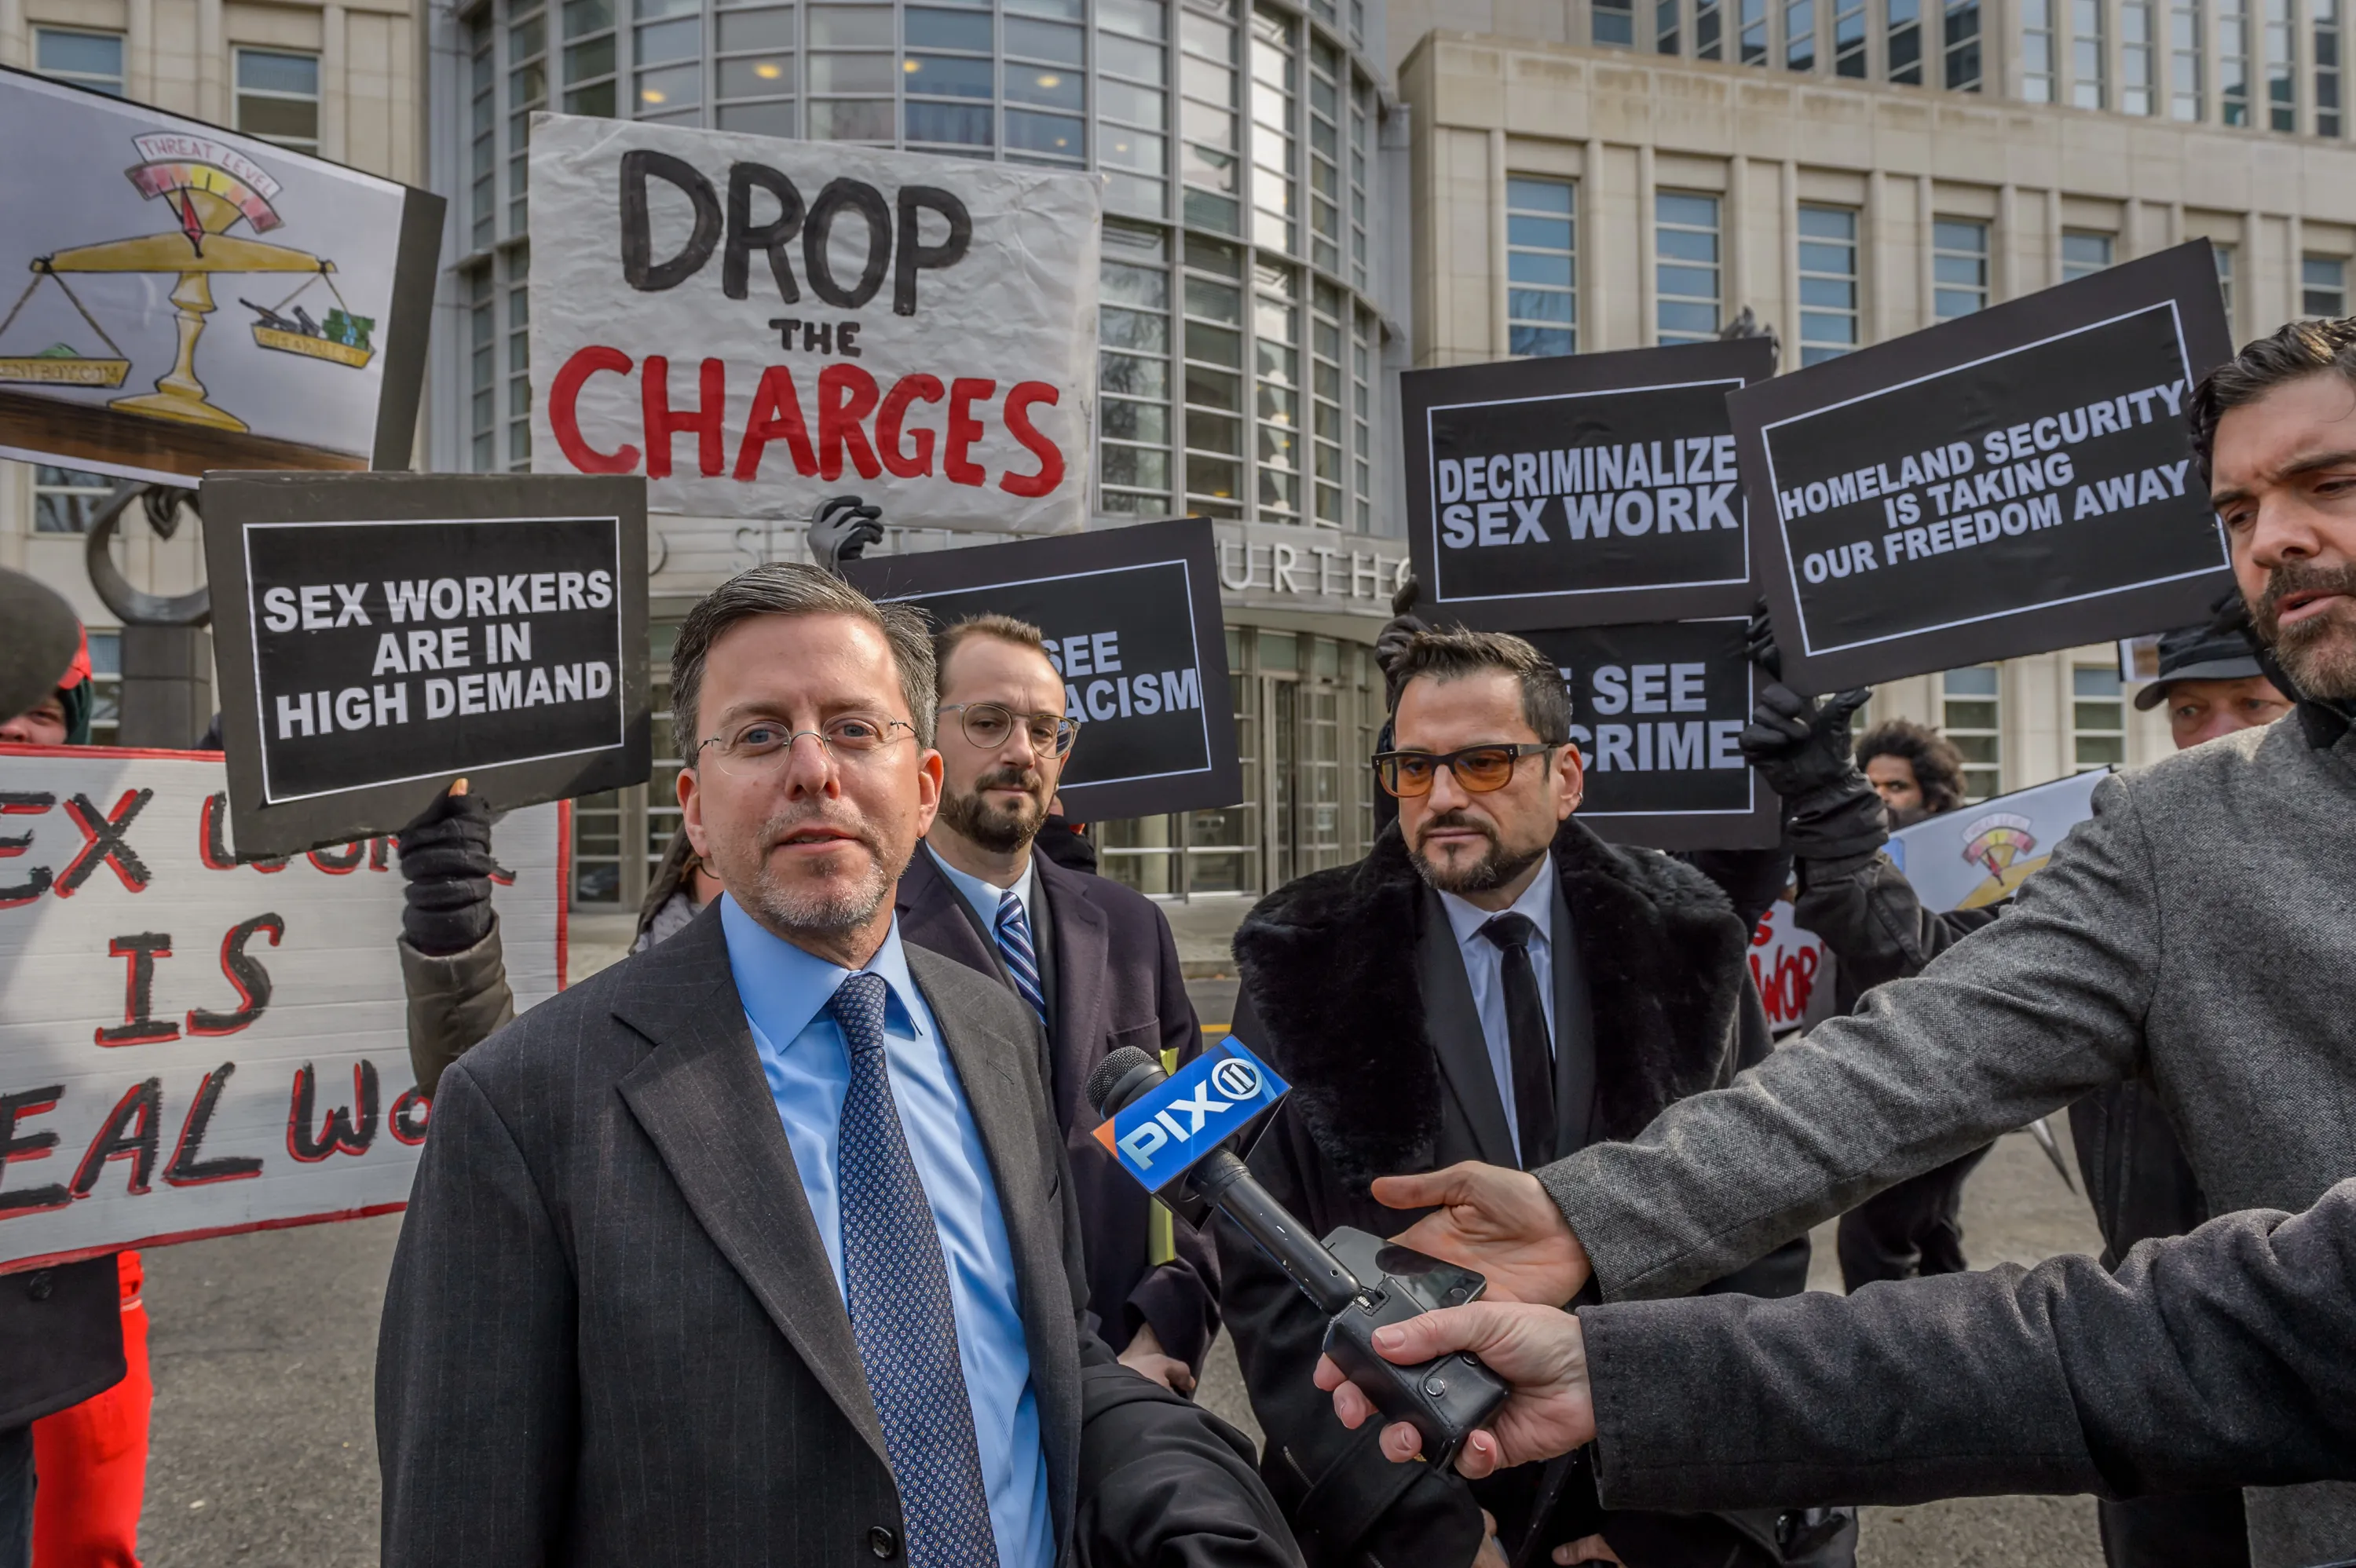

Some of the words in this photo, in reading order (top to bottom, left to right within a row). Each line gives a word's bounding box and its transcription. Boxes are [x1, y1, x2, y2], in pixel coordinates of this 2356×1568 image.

[139, 139, 215, 159] THREAT
[221, 152, 272, 198] LEVEL
[620, 149, 973, 316] DROP
[768, 318, 862, 356] THE
[548, 345, 1066, 498] CHARGES
[1780, 440, 1974, 521] HOMELAND
[1985, 380, 2185, 464] SECURITY
[1439, 435, 1737, 503] DECRIMINALIZE
[1885, 495, 1920, 528] IS
[1927, 453, 2073, 514] TAKING
[1442, 499, 1550, 549] SEX
[1563, 483, 1740, 540] WORK
[1803, 539, 1878, 585] OUR
[1882, 492, 2062, 566] FREEDOM
[2073, 459, 2190, 522] AWAY
[264, 581, 372, 633] SEX
[382, 569, 613, 624] WORKERS
[371, 626, 471, 677] ARE
[485, 622, 532, 664] IN
[1041, 630, 1121, 678] SEE
[275, 684, 409, 740] HIGH
[424, 660, 613, 722] DEMAND
[1065, 667, 1200, 723] ACISM
[1592, 663, 1707, 715] SEE
[94, 912, 284, 1047] IS
[1748, 940, 1827, 1024] WOR
[0, 1062, 263, 1218] EAL
[1116, 1078, 1235, 1171] PIX
